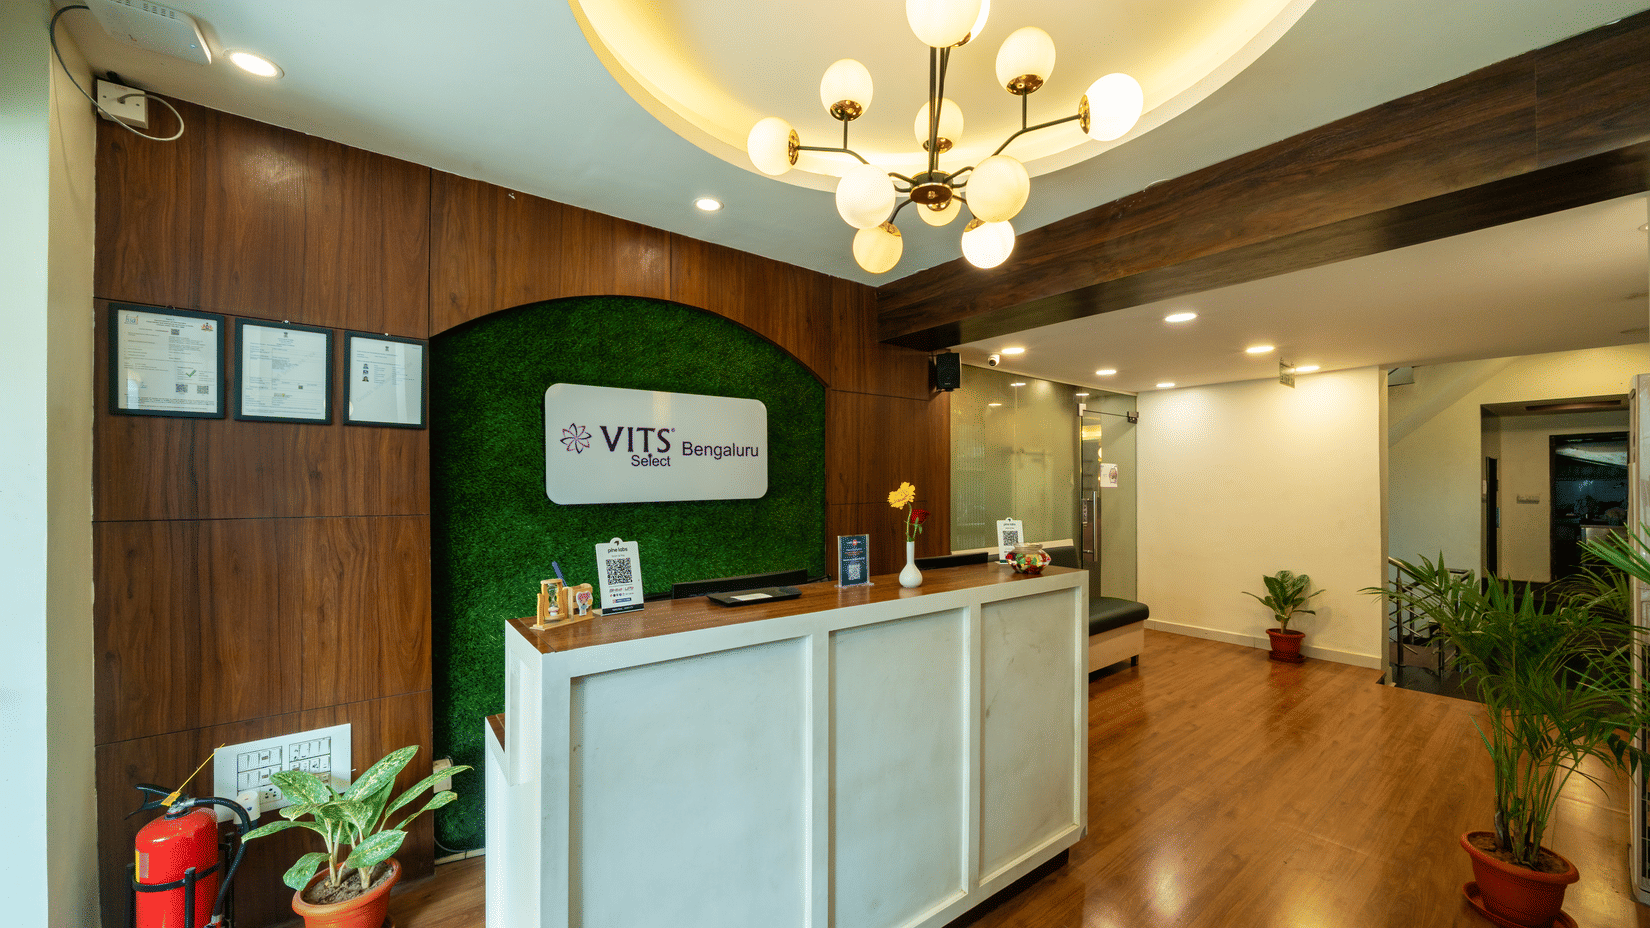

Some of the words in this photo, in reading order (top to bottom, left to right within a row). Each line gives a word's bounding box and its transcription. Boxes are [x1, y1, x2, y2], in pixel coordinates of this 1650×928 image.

[599, 425, 671, 453] VITS
[631, 453, 671, 467] Select
[682, 441, 759, 460] Bengaluru
